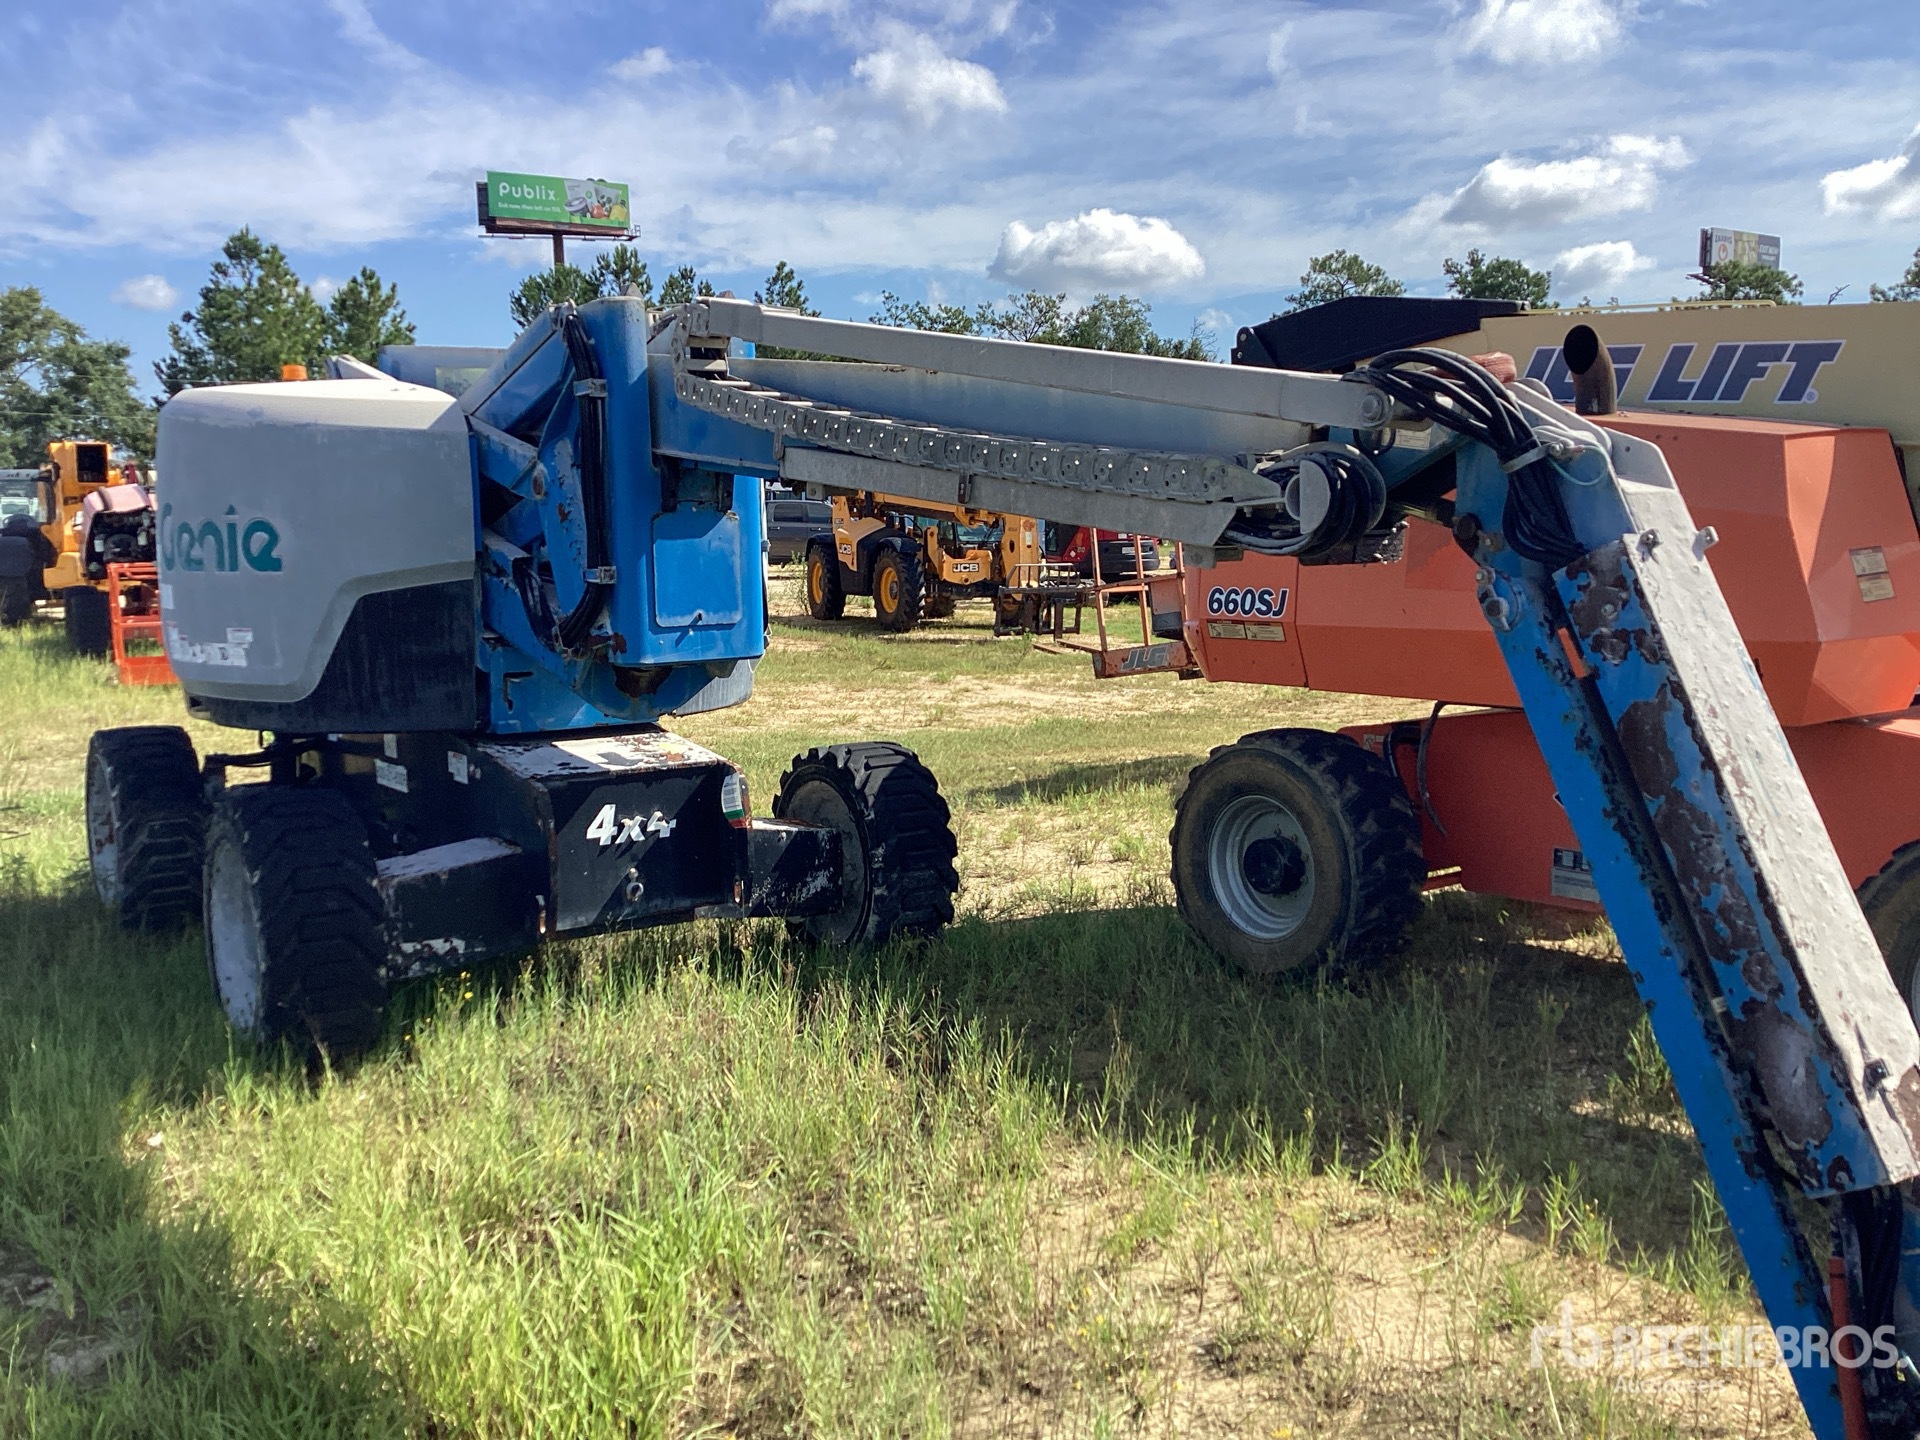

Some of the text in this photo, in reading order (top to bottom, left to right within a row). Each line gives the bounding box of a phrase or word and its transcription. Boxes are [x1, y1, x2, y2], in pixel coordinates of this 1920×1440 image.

[499, 182, 555, 200] Publix
[1644, 339, 1846, 404] LIFT
[162, 502, 283, 572] Genie
[952, 563, 979, 572] JCB
[1207, 586, 1289, 618] 660SJ
[586, 804, 677, 846] 4x4
